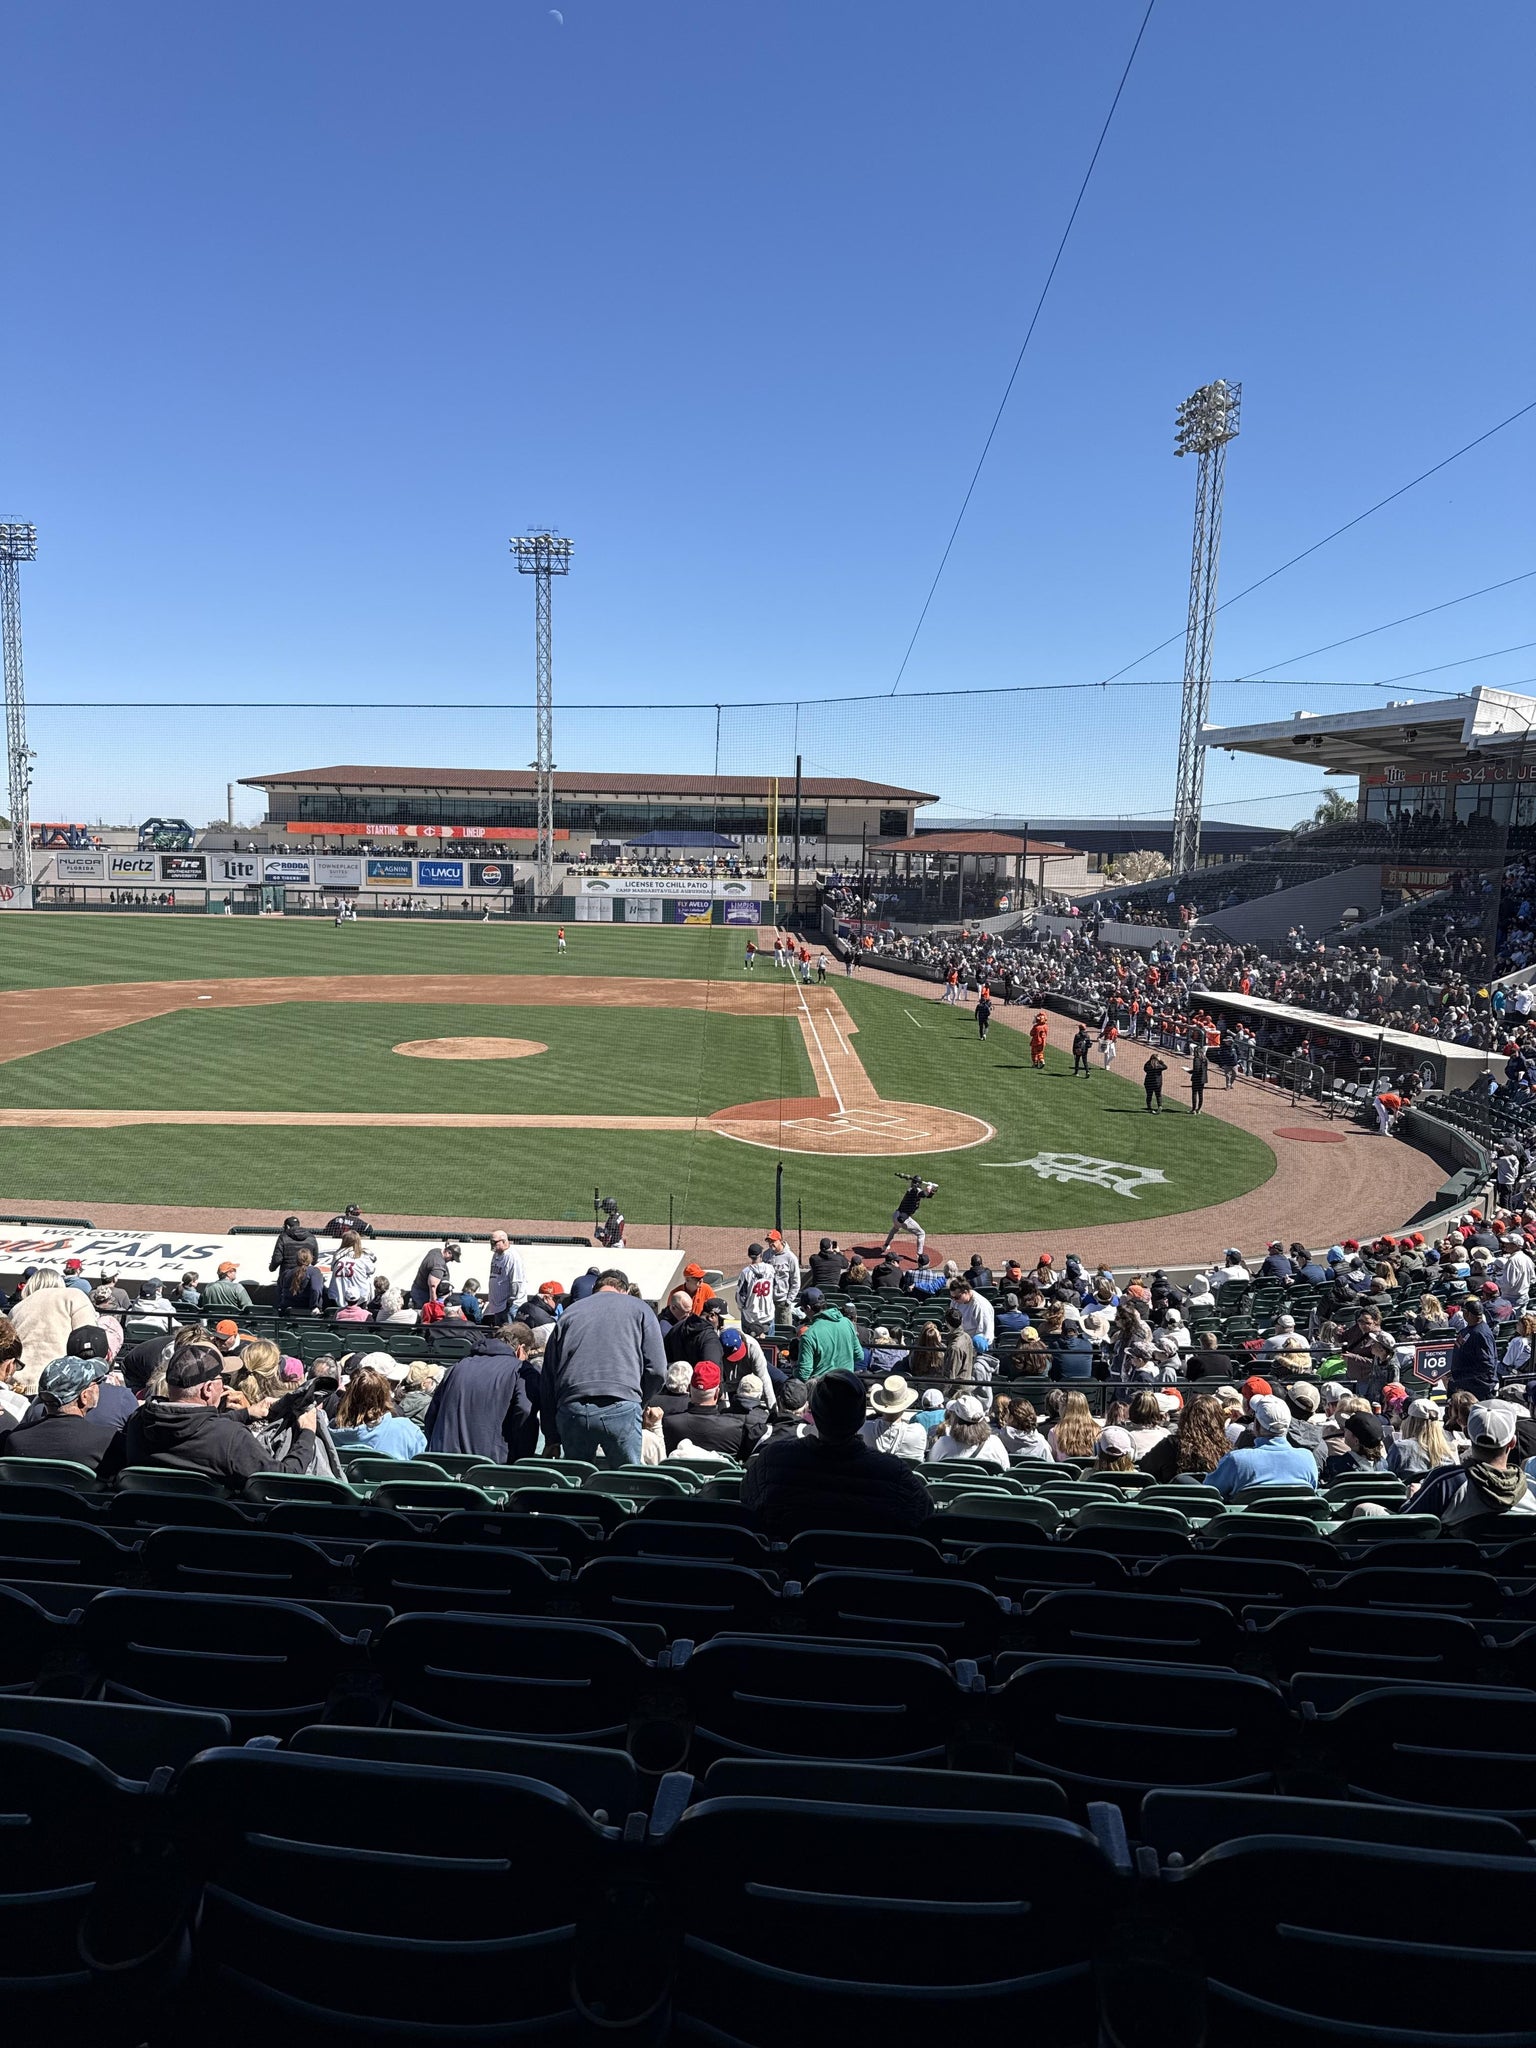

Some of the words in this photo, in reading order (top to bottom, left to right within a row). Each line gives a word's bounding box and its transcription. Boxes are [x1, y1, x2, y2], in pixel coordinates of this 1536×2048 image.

[1420, 771, 1449, 783] THE
[366, 825, 399, 836] STARTING
[462, 828, 486, 838] LINEUP
[112, 858, 154, 872] Hertz
[223, 861, 254, 880] Lite
[431, 867, 461, 877] LMCU
[42, 1228, 155, 1240] WELCOME
[74, 1240, 224, 1260] FANS
[158, 1262, 185, 1271] FL
[335, 1261, 356, 1278] 23
[752, 1280, 771, 1297] 48
[1423, 1357, 1447, 1369] 108
